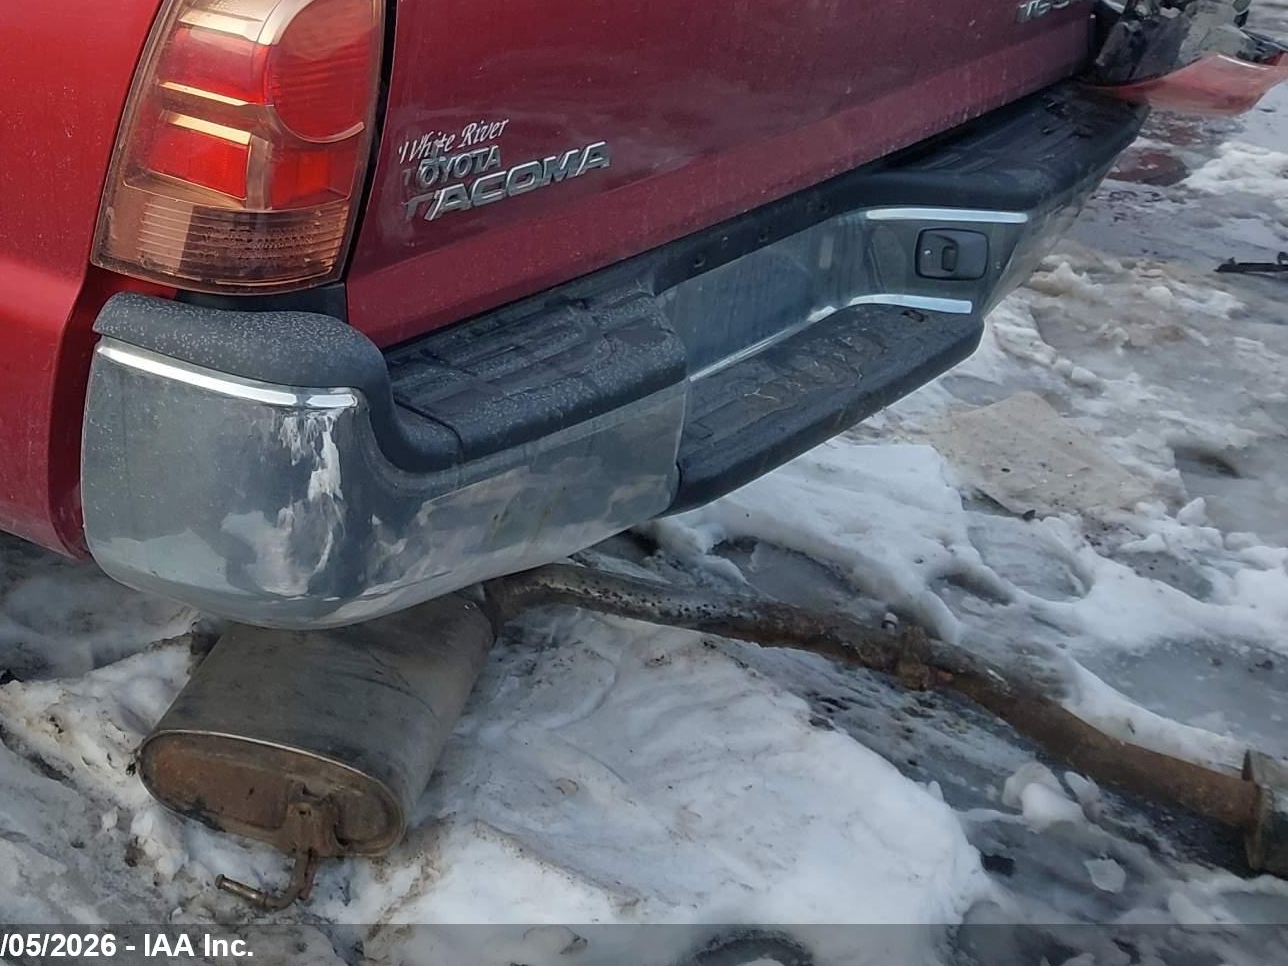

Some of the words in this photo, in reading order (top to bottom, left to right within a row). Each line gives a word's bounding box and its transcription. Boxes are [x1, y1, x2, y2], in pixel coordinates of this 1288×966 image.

[398, 131, 456, 165] White
[457, 119, 510, 149] River
[401, 144, 501, 187] TOYOTA
[401, 141, 611, 221] TACOMA
